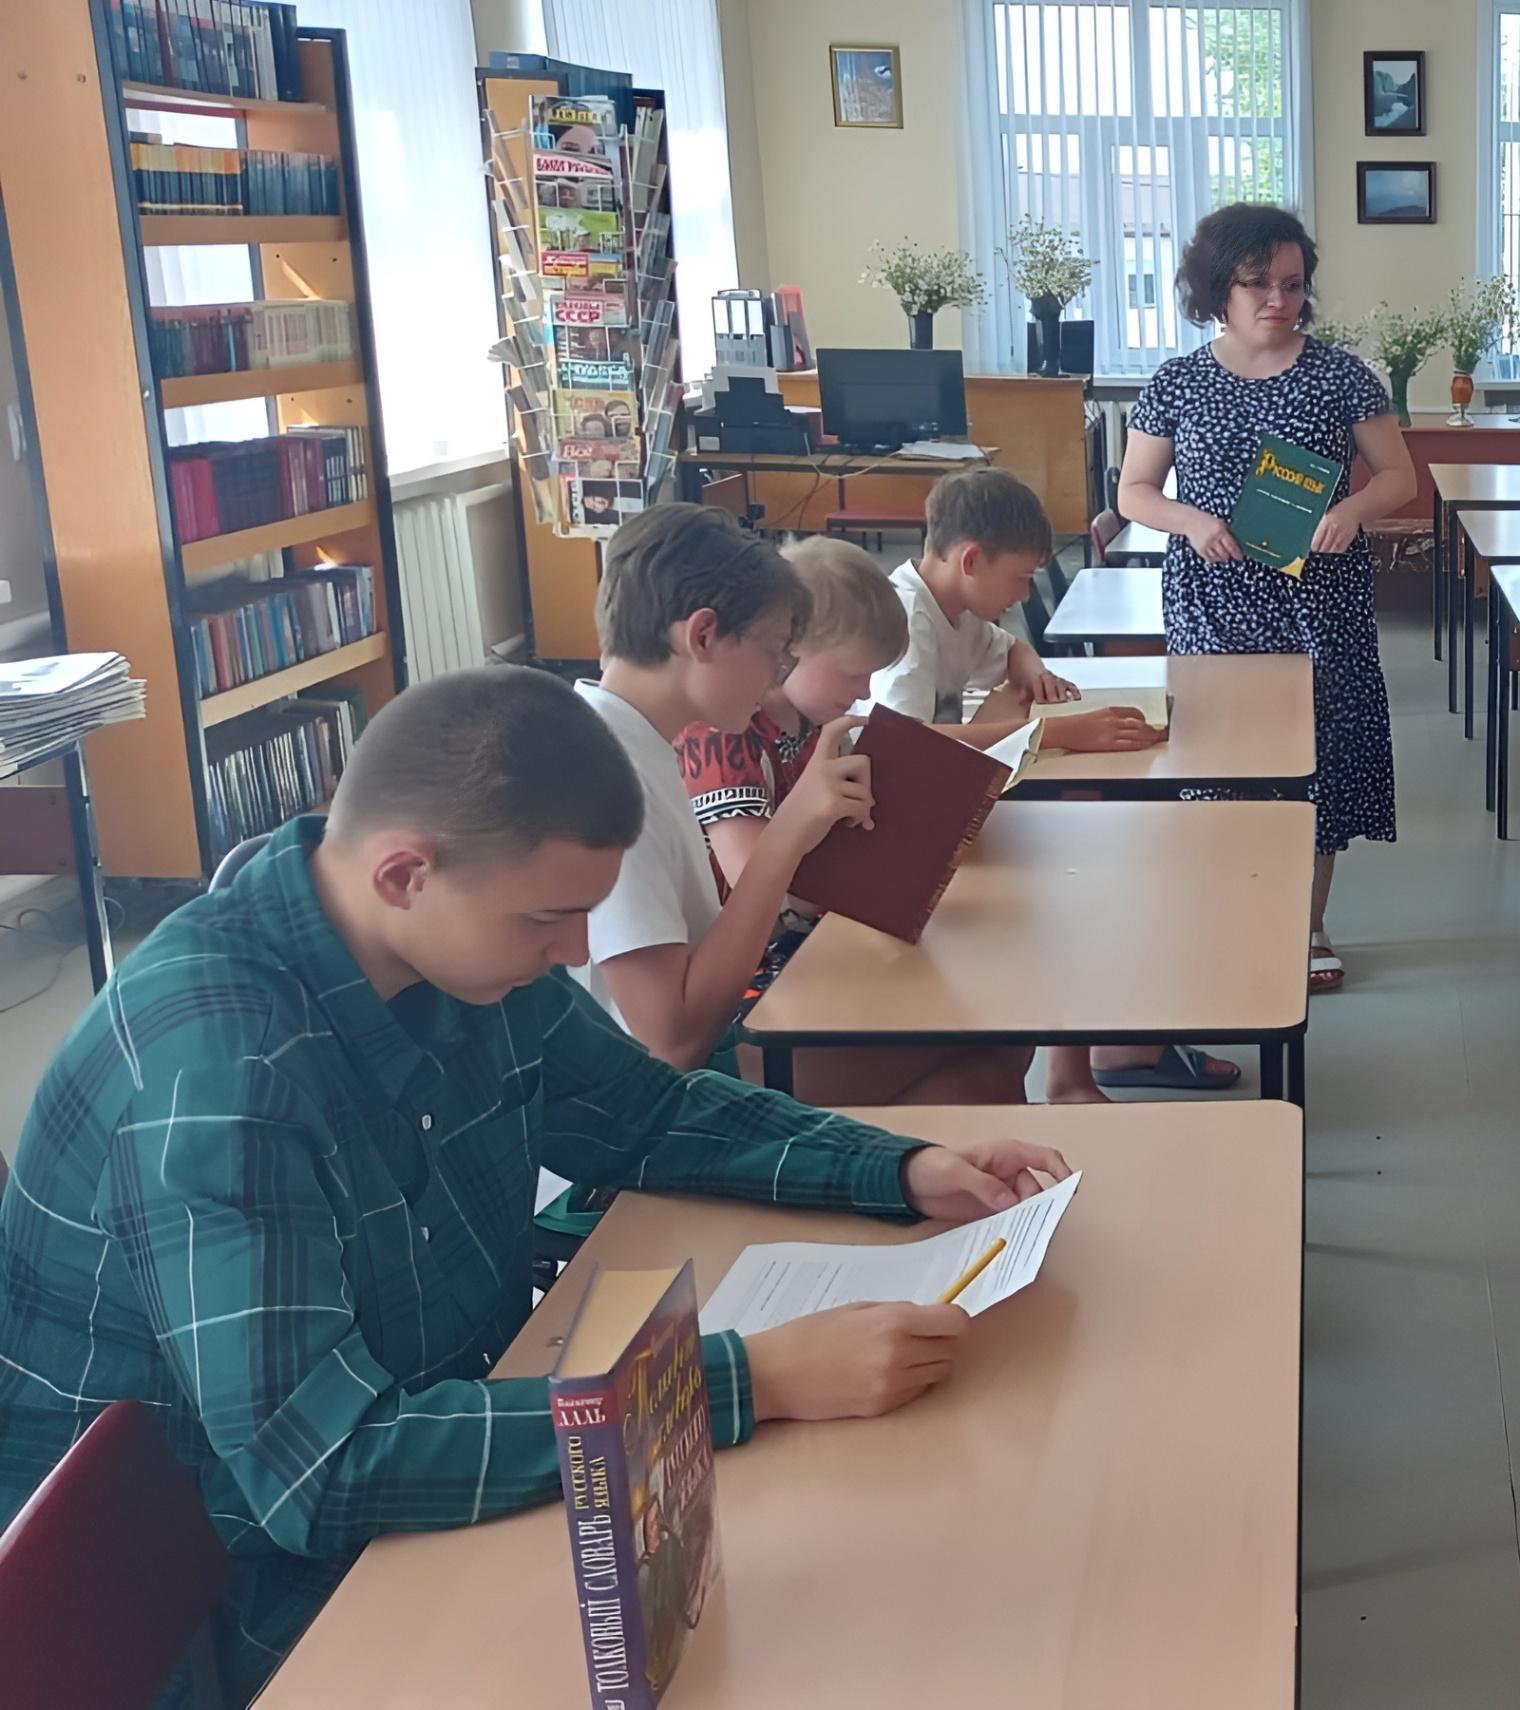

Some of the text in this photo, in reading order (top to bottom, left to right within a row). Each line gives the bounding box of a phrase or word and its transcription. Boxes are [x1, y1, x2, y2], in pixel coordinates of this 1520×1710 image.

[555, 310, 600, 323] СССР
[577, 1513, 619, 1591] СЛОВАРЬ
[579, 1597, 630, 1693] ТОЛКОВЫЙ
